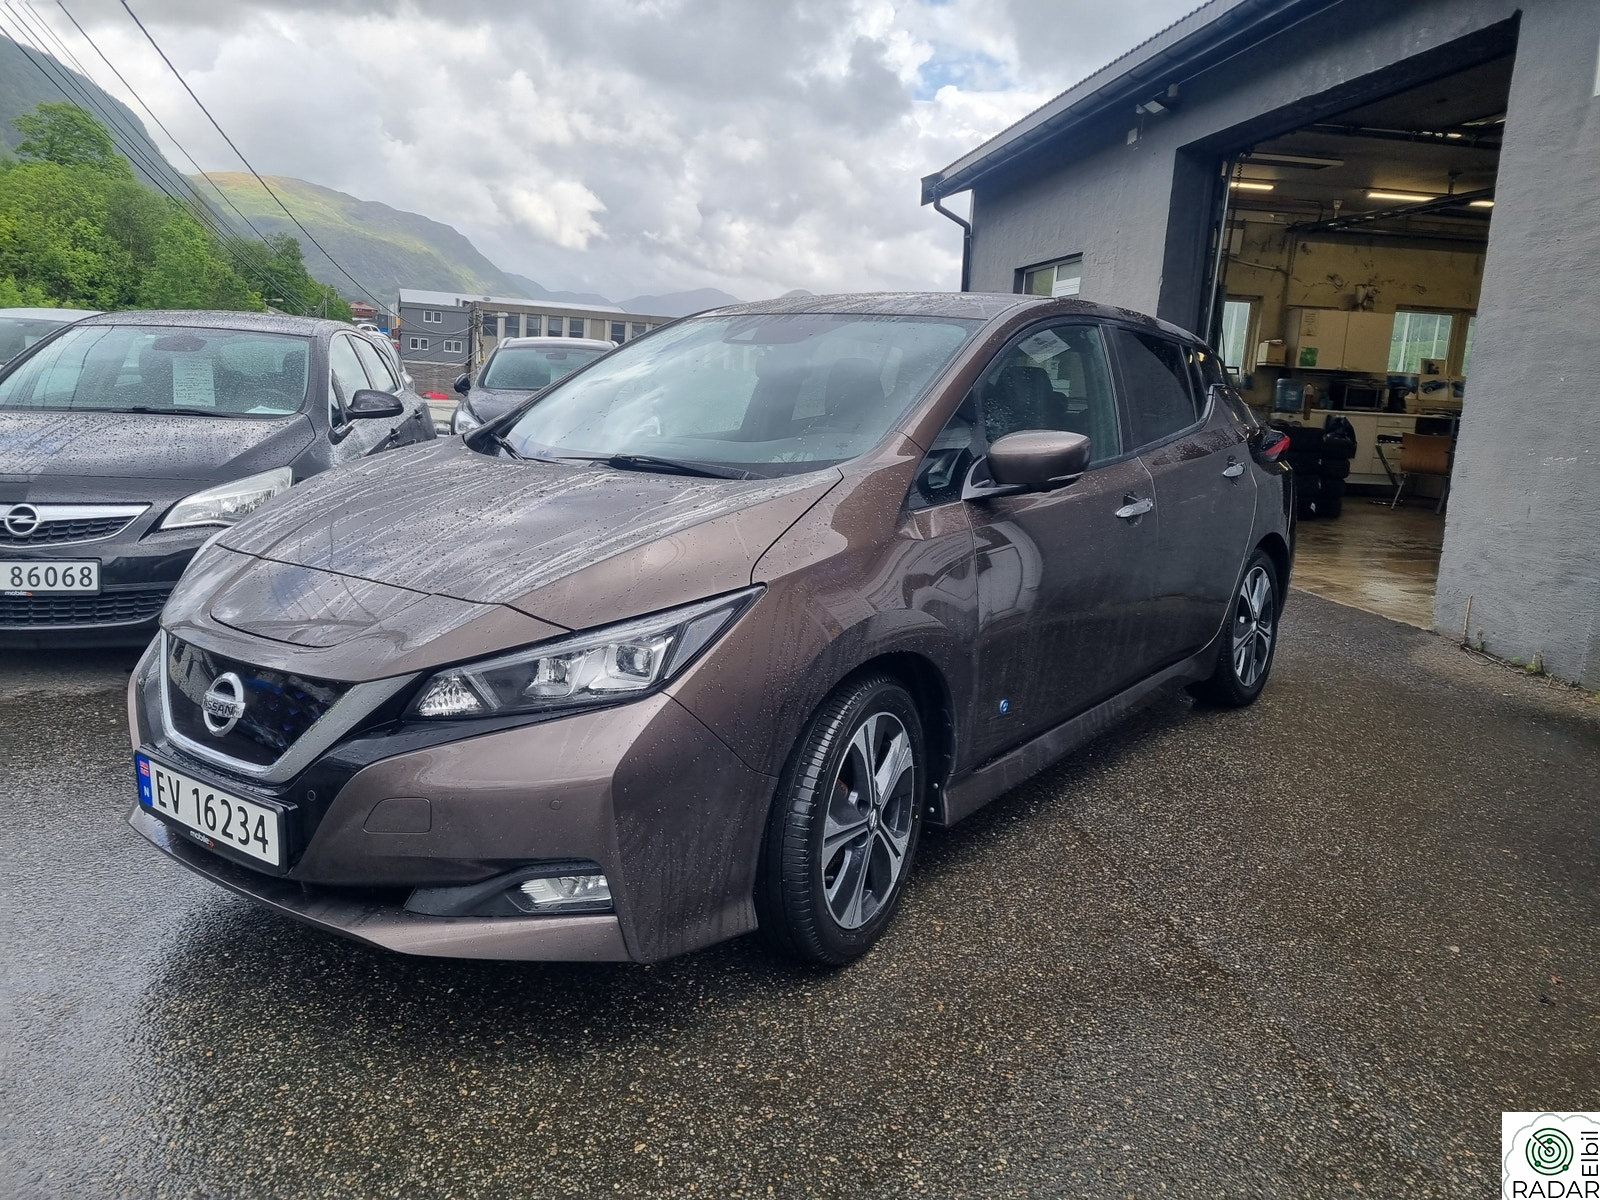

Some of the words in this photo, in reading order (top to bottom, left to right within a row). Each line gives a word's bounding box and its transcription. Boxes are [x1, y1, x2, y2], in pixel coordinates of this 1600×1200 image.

[10, 566, 93, 587] 86068
[143, 785, 150, 798] N
[155, 769, 180, 814] EV
[192, 787, 269, 854] 16234
